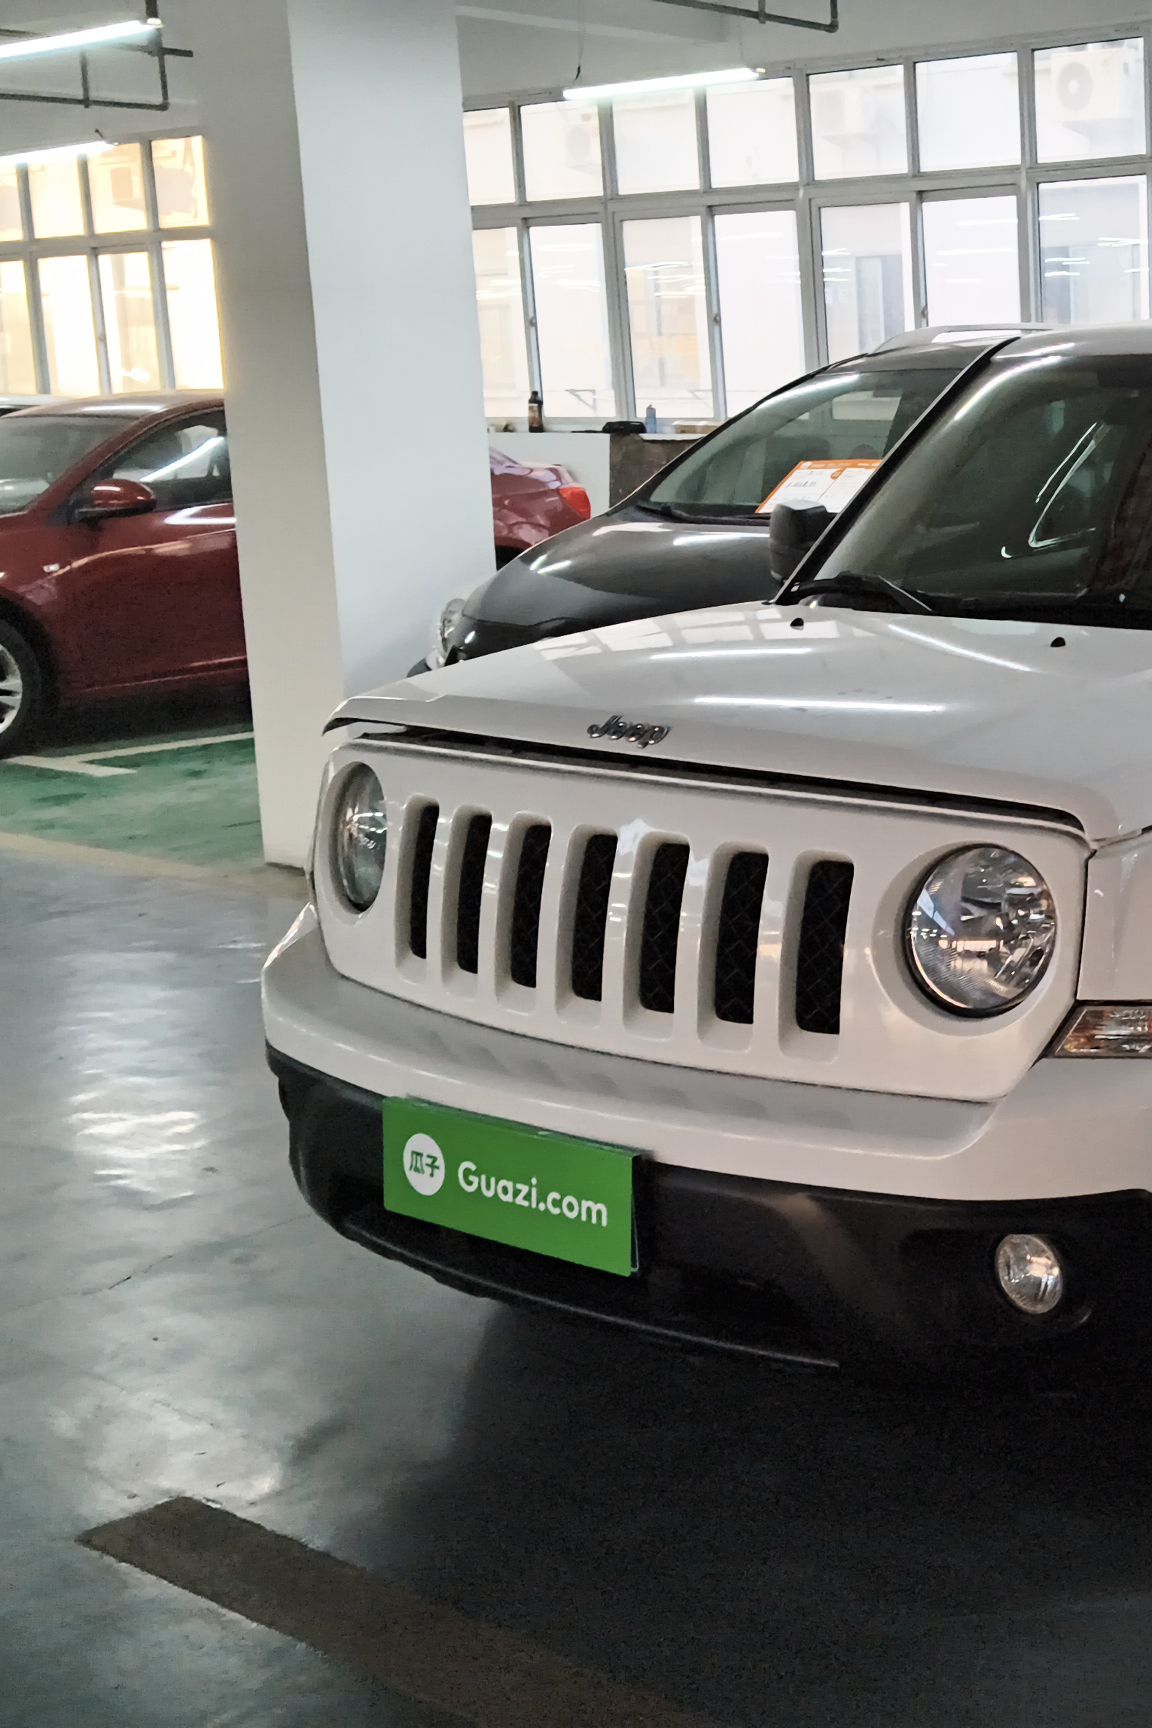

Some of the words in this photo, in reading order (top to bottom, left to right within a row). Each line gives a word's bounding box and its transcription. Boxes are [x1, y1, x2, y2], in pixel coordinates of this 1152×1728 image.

[587, 714, 671, 749] Jeep
[409, 1150, 440, 1178] 瓜子
[457, 1160, 608, 1227] Guazi.com
